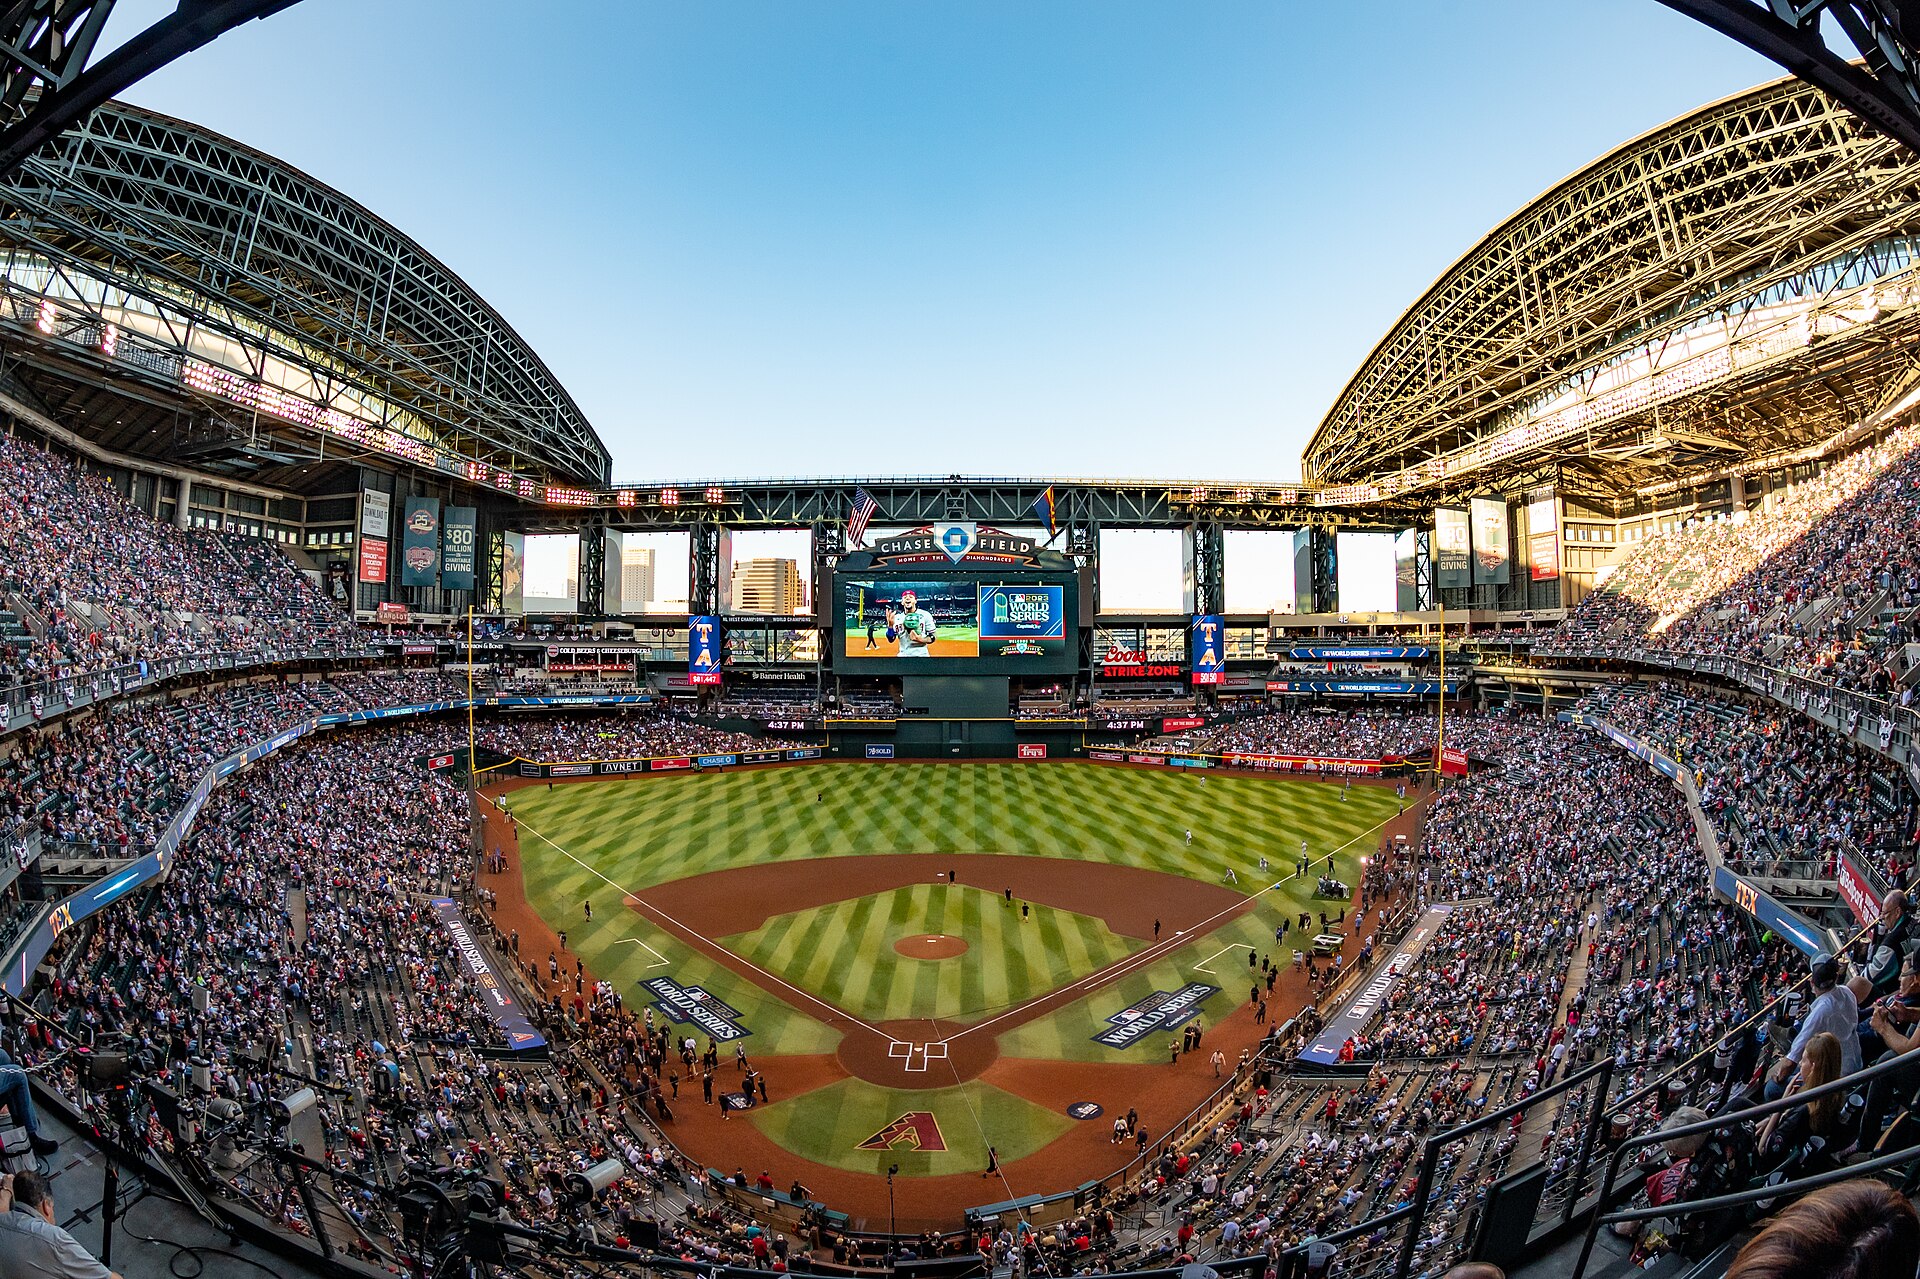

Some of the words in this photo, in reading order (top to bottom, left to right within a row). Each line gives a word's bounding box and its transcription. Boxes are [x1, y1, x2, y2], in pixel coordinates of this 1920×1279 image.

[415, 514, 428, 526] 25
[446, 530, 473, 544] $80
[881, 539, 931, 553] CHASE
[980, 538, 1030, 553] FIELD
[966, 555, 1012, 563] DIAMONDBACKS
[445, 563, 471, 572] GIVING
[1441, 561, 1467, 570] GIVING
[1009, 602, 1050, 612] WORLD
[1009, 612, 1050, 621] SERIES
[1338, 614, 1349, 624] 42
[1366, 614, 1378, 623] 20
[696, 623, 713, 643] T
[1200, 622, 1217, 643] T
[694, 648, 713, 666] A
[1104, 645, 1147, 663] Coors
[1146, 650, 1183, 662] LIGHT
[1198, 647, 1217, 666] A
[759, 672, 783, 680] Banner
[783, 672, 805, 680] Health
[1104, 666, 1145, 677] STRIKE
[1146, 665, 1179, 676] ZONE
[767, 721, 788, 730] 4:37
[791, 721, 804, 730] PM
[1107, 721, 1128, 729] 4:37
[1131, 720, 1144, 729] PM
[1021, 746, 1043, 757] fry's
[605, 762, 638, 771] AVNET
[1735, 879, 1759, 916] TEX
[48, 901, 75, 939] TEX
[452, 926, 473, 952] WORLD
[464, 949, 490, 974] SERIES
[1356, 972, 1393, 1007] WORLD
[650, 978, 696, 1009] WORLD
[688, 1002, 741, 1040] SERIES
[1101, 1011, 1167, 1045] WORLD
[1158, 985, 1212, 1014] SERIES
[1311, 1044, 1334, 1054] T
